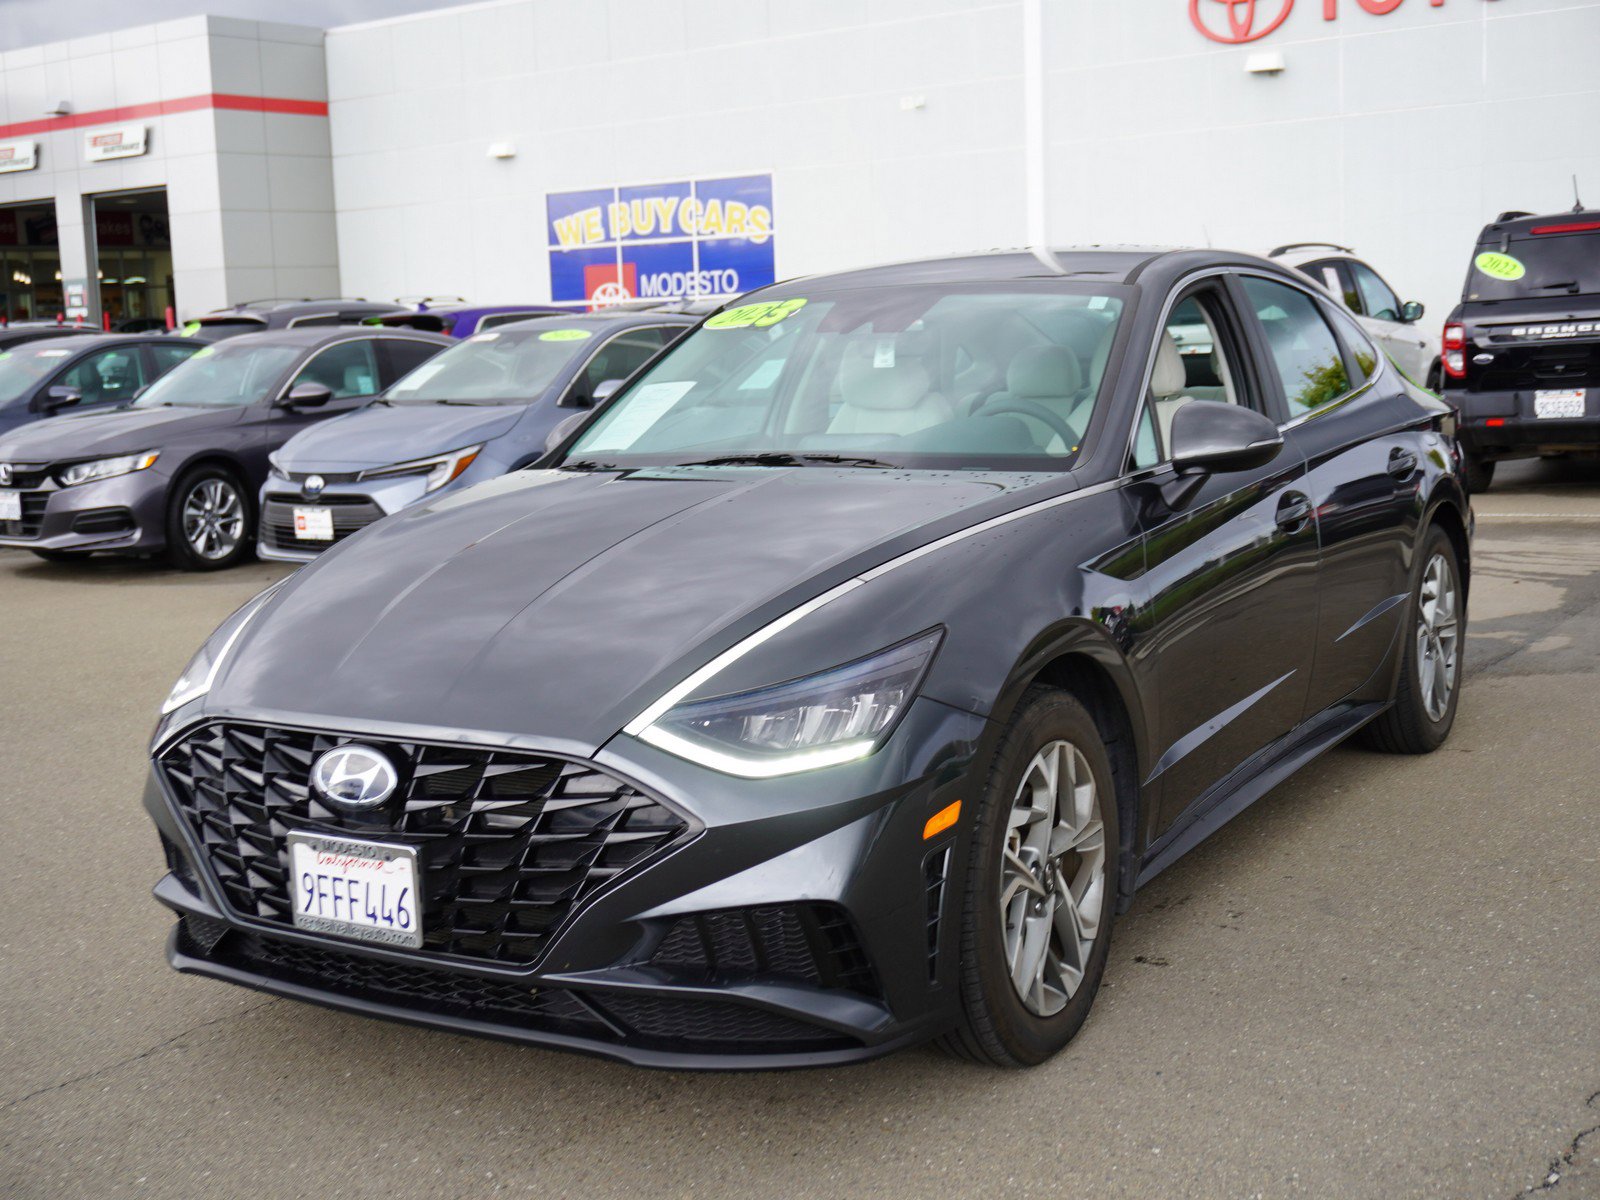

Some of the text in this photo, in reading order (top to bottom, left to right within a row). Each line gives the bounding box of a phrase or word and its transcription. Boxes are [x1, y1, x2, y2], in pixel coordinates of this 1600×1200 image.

[553, 196, 771, 252] WE BUY CARS
[640, 269, 739, 298] MODESTO
[302, 872, 411, 929] 9FFF446
